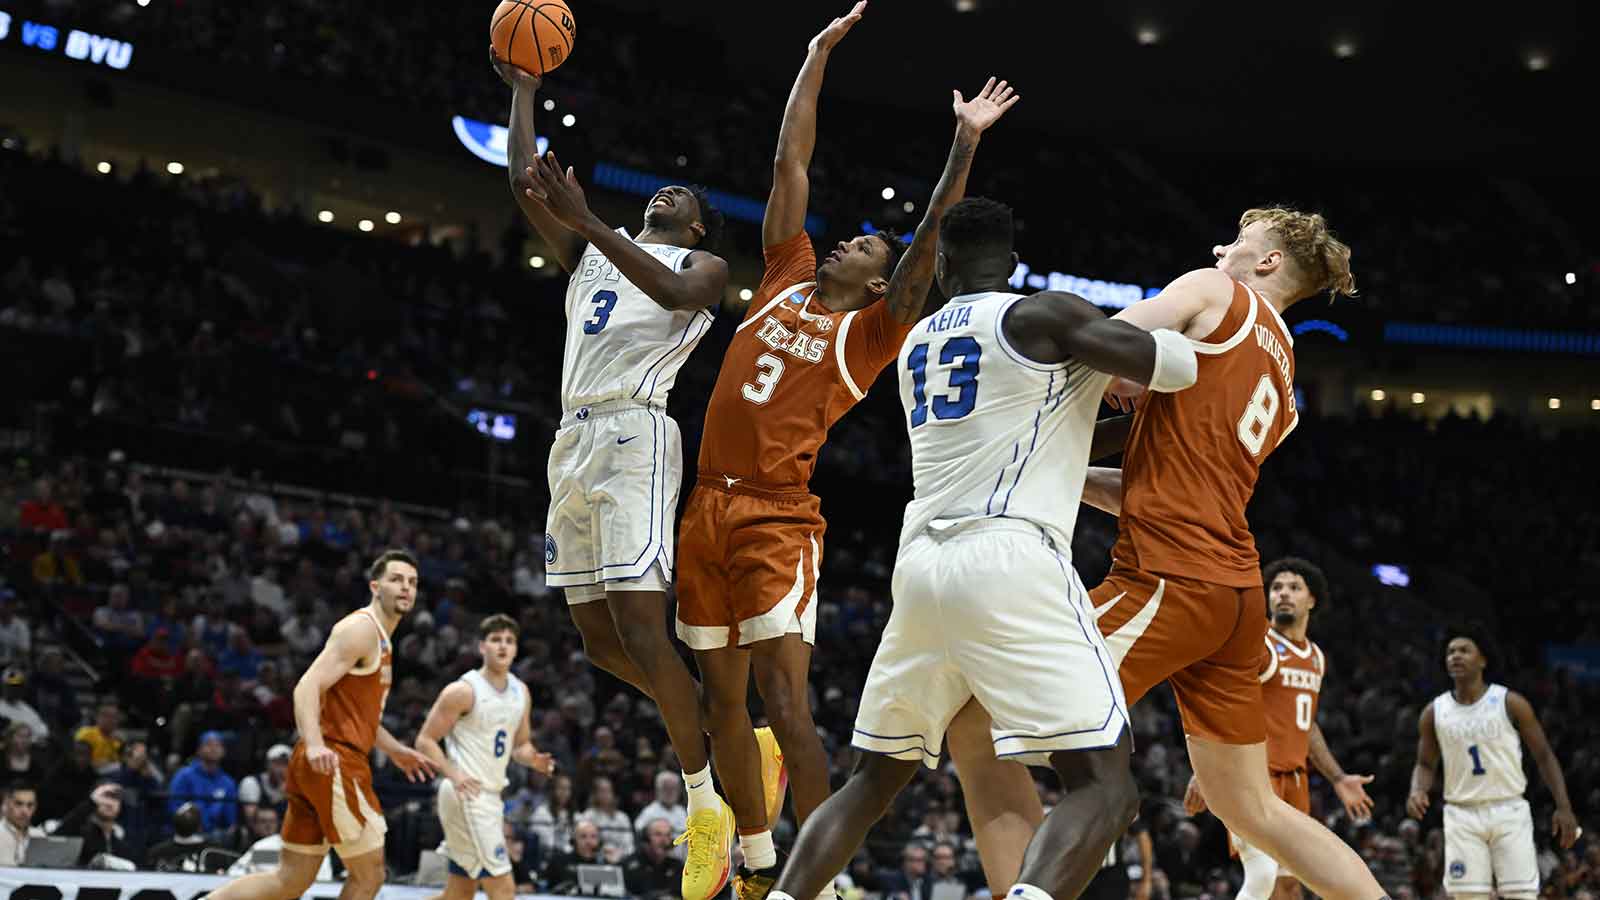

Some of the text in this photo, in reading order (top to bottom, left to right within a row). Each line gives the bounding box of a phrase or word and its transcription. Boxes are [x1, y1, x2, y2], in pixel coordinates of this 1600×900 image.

[65, 29, 133, 69] BYU
[583, 289, 618, 335] 3
[926, 305, 973, 333] KEITA
[741, 352, 785, 405] 3
[907, 336, 983, 429] 13
[1237, 373, 1279, 456] 8
[1295, 692, 1312, 732] 0
[493, 728, 507, 758] 6
[1468, 744, 1486, 776] 1
